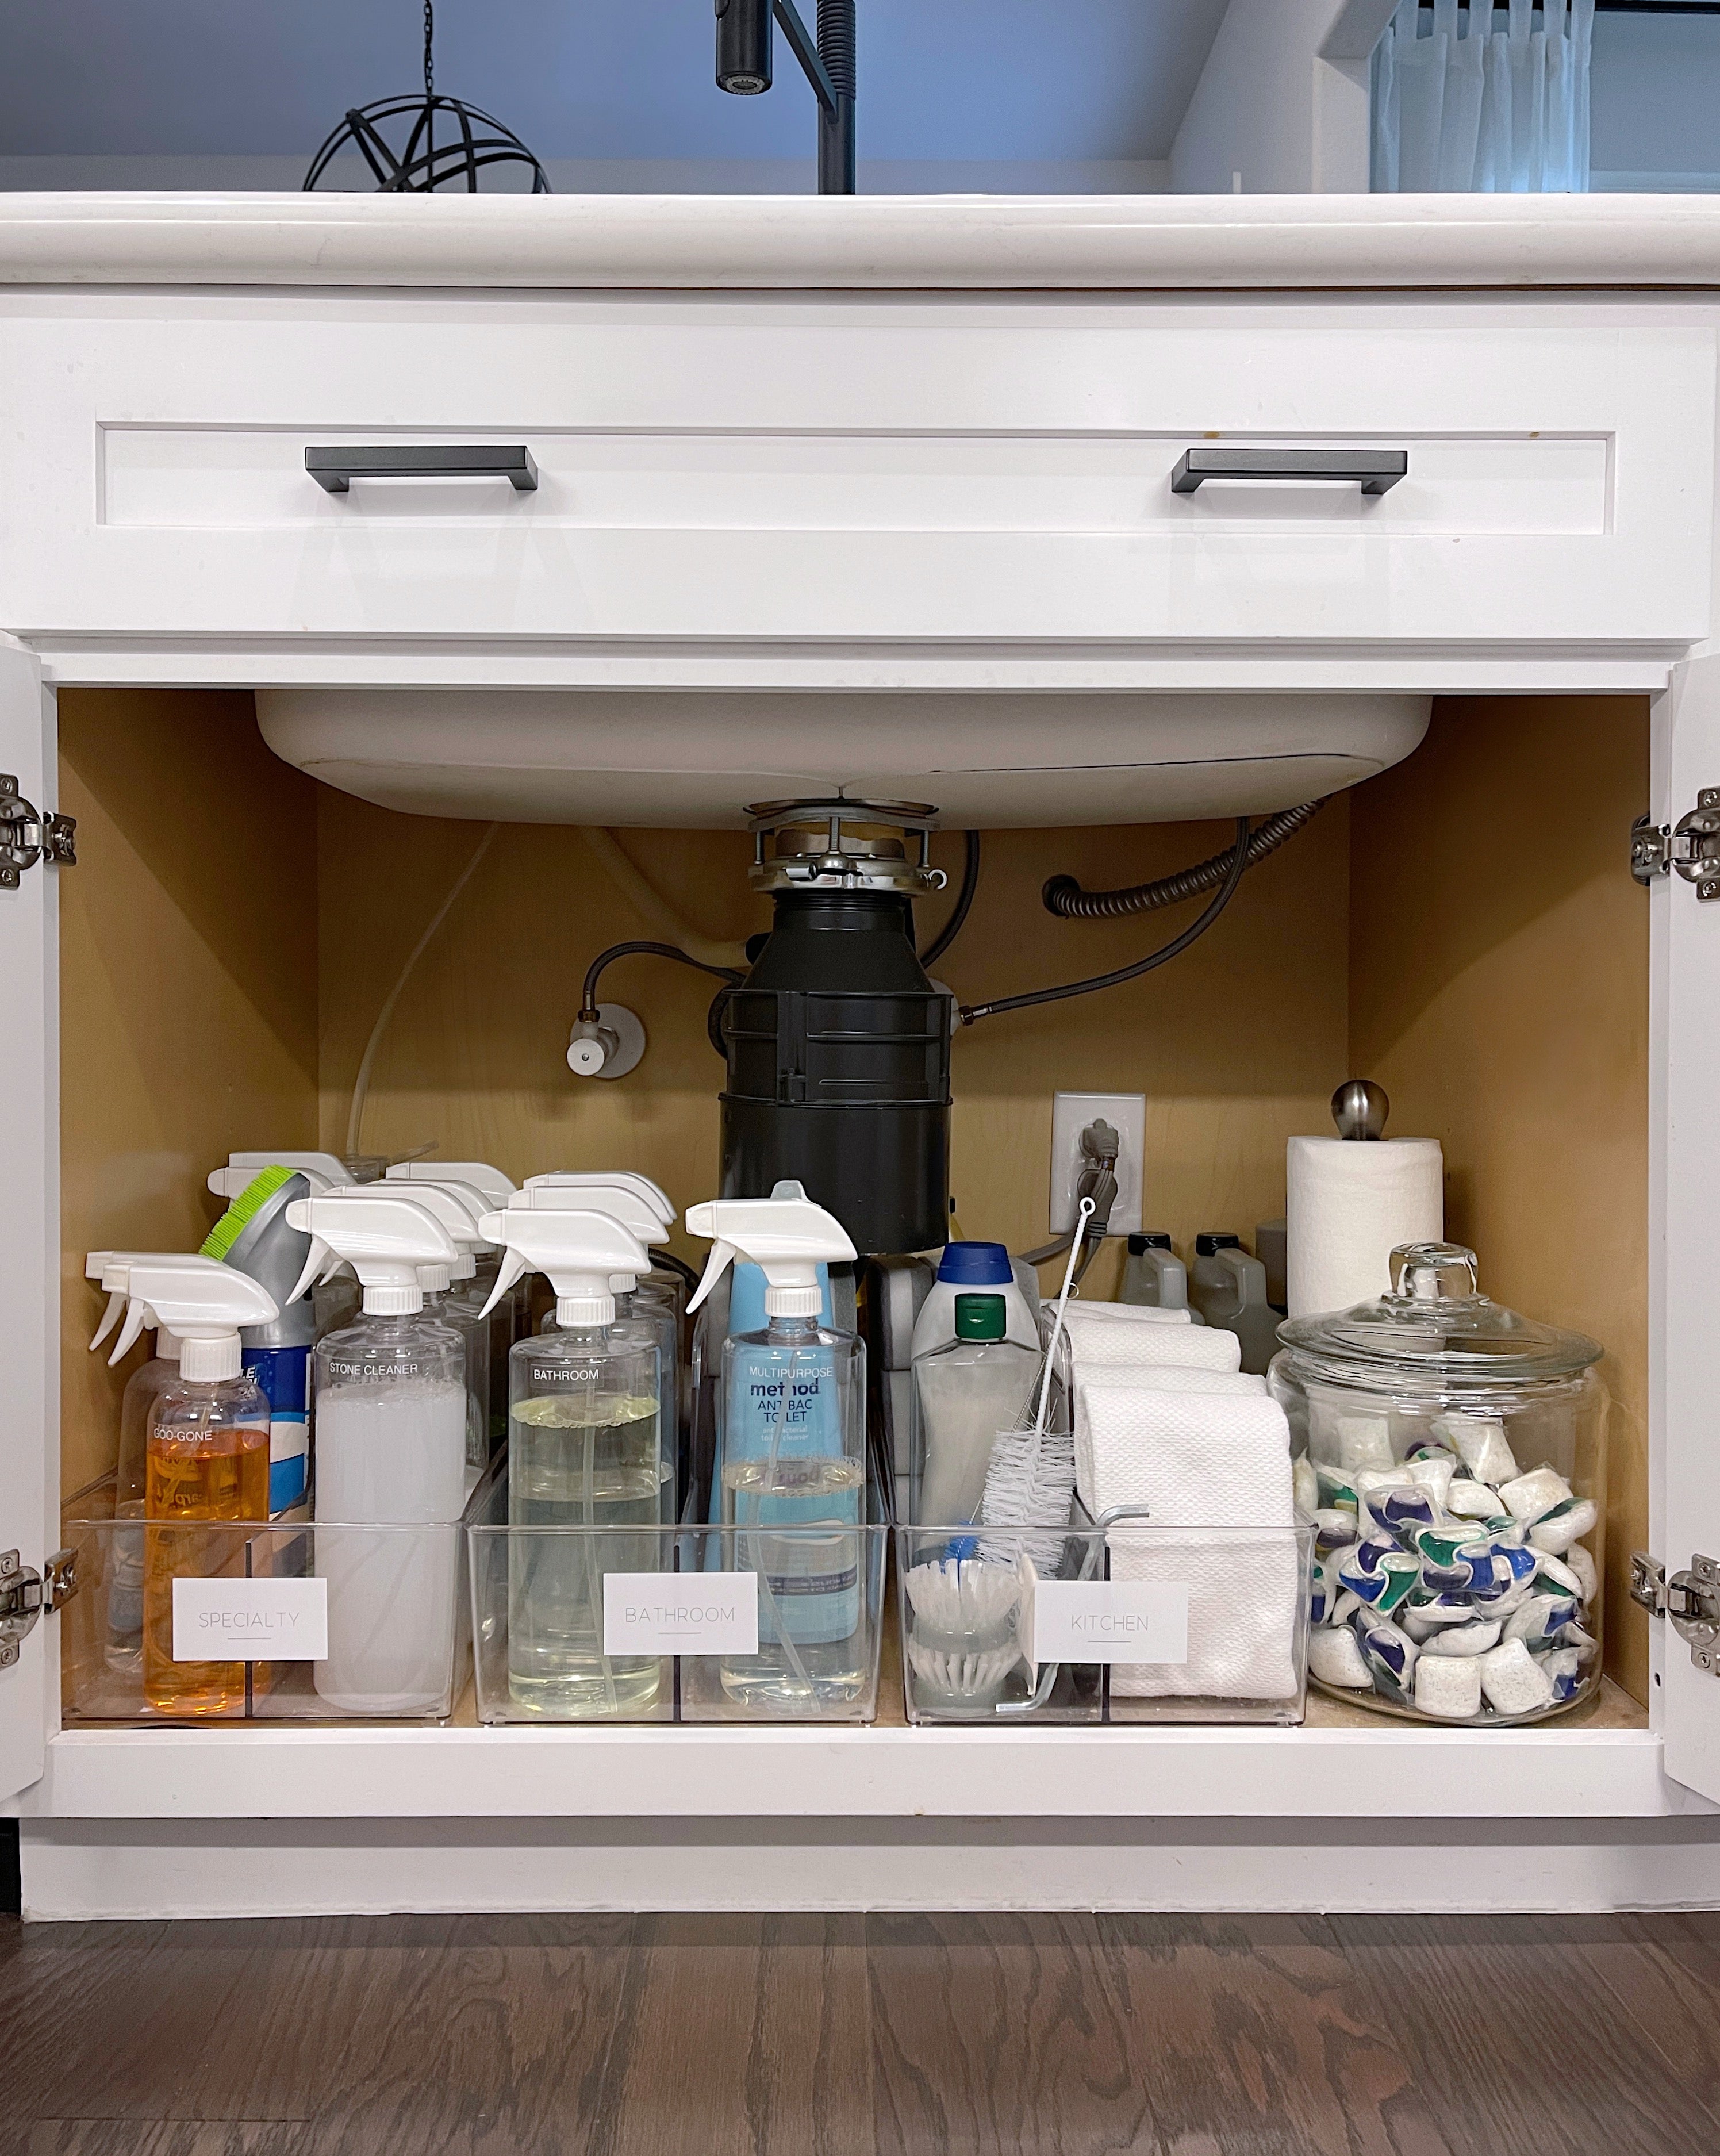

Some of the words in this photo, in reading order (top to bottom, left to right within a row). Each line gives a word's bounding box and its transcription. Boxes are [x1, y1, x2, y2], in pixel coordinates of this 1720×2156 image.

[329, 1362, 361, 1375] STONE
[363, 1364, 418, 1375] CLEANER
[533, 1369, 598, 1380] BATHROOM
[749, 1366, 834, 1379] MULTIPURPOSE
[758, 1399, 812, 1410] ANTBAC
[763, 1411, 807, 1422] TOLET
[153, 1428, 213, 1441] GOO-GONE
[199, 1612, 300, 1628] SPECIALTY
[625, 1607, 734, 1622] BATHROOM
[1072, 1615, 1148, 1631] KITCHEN
